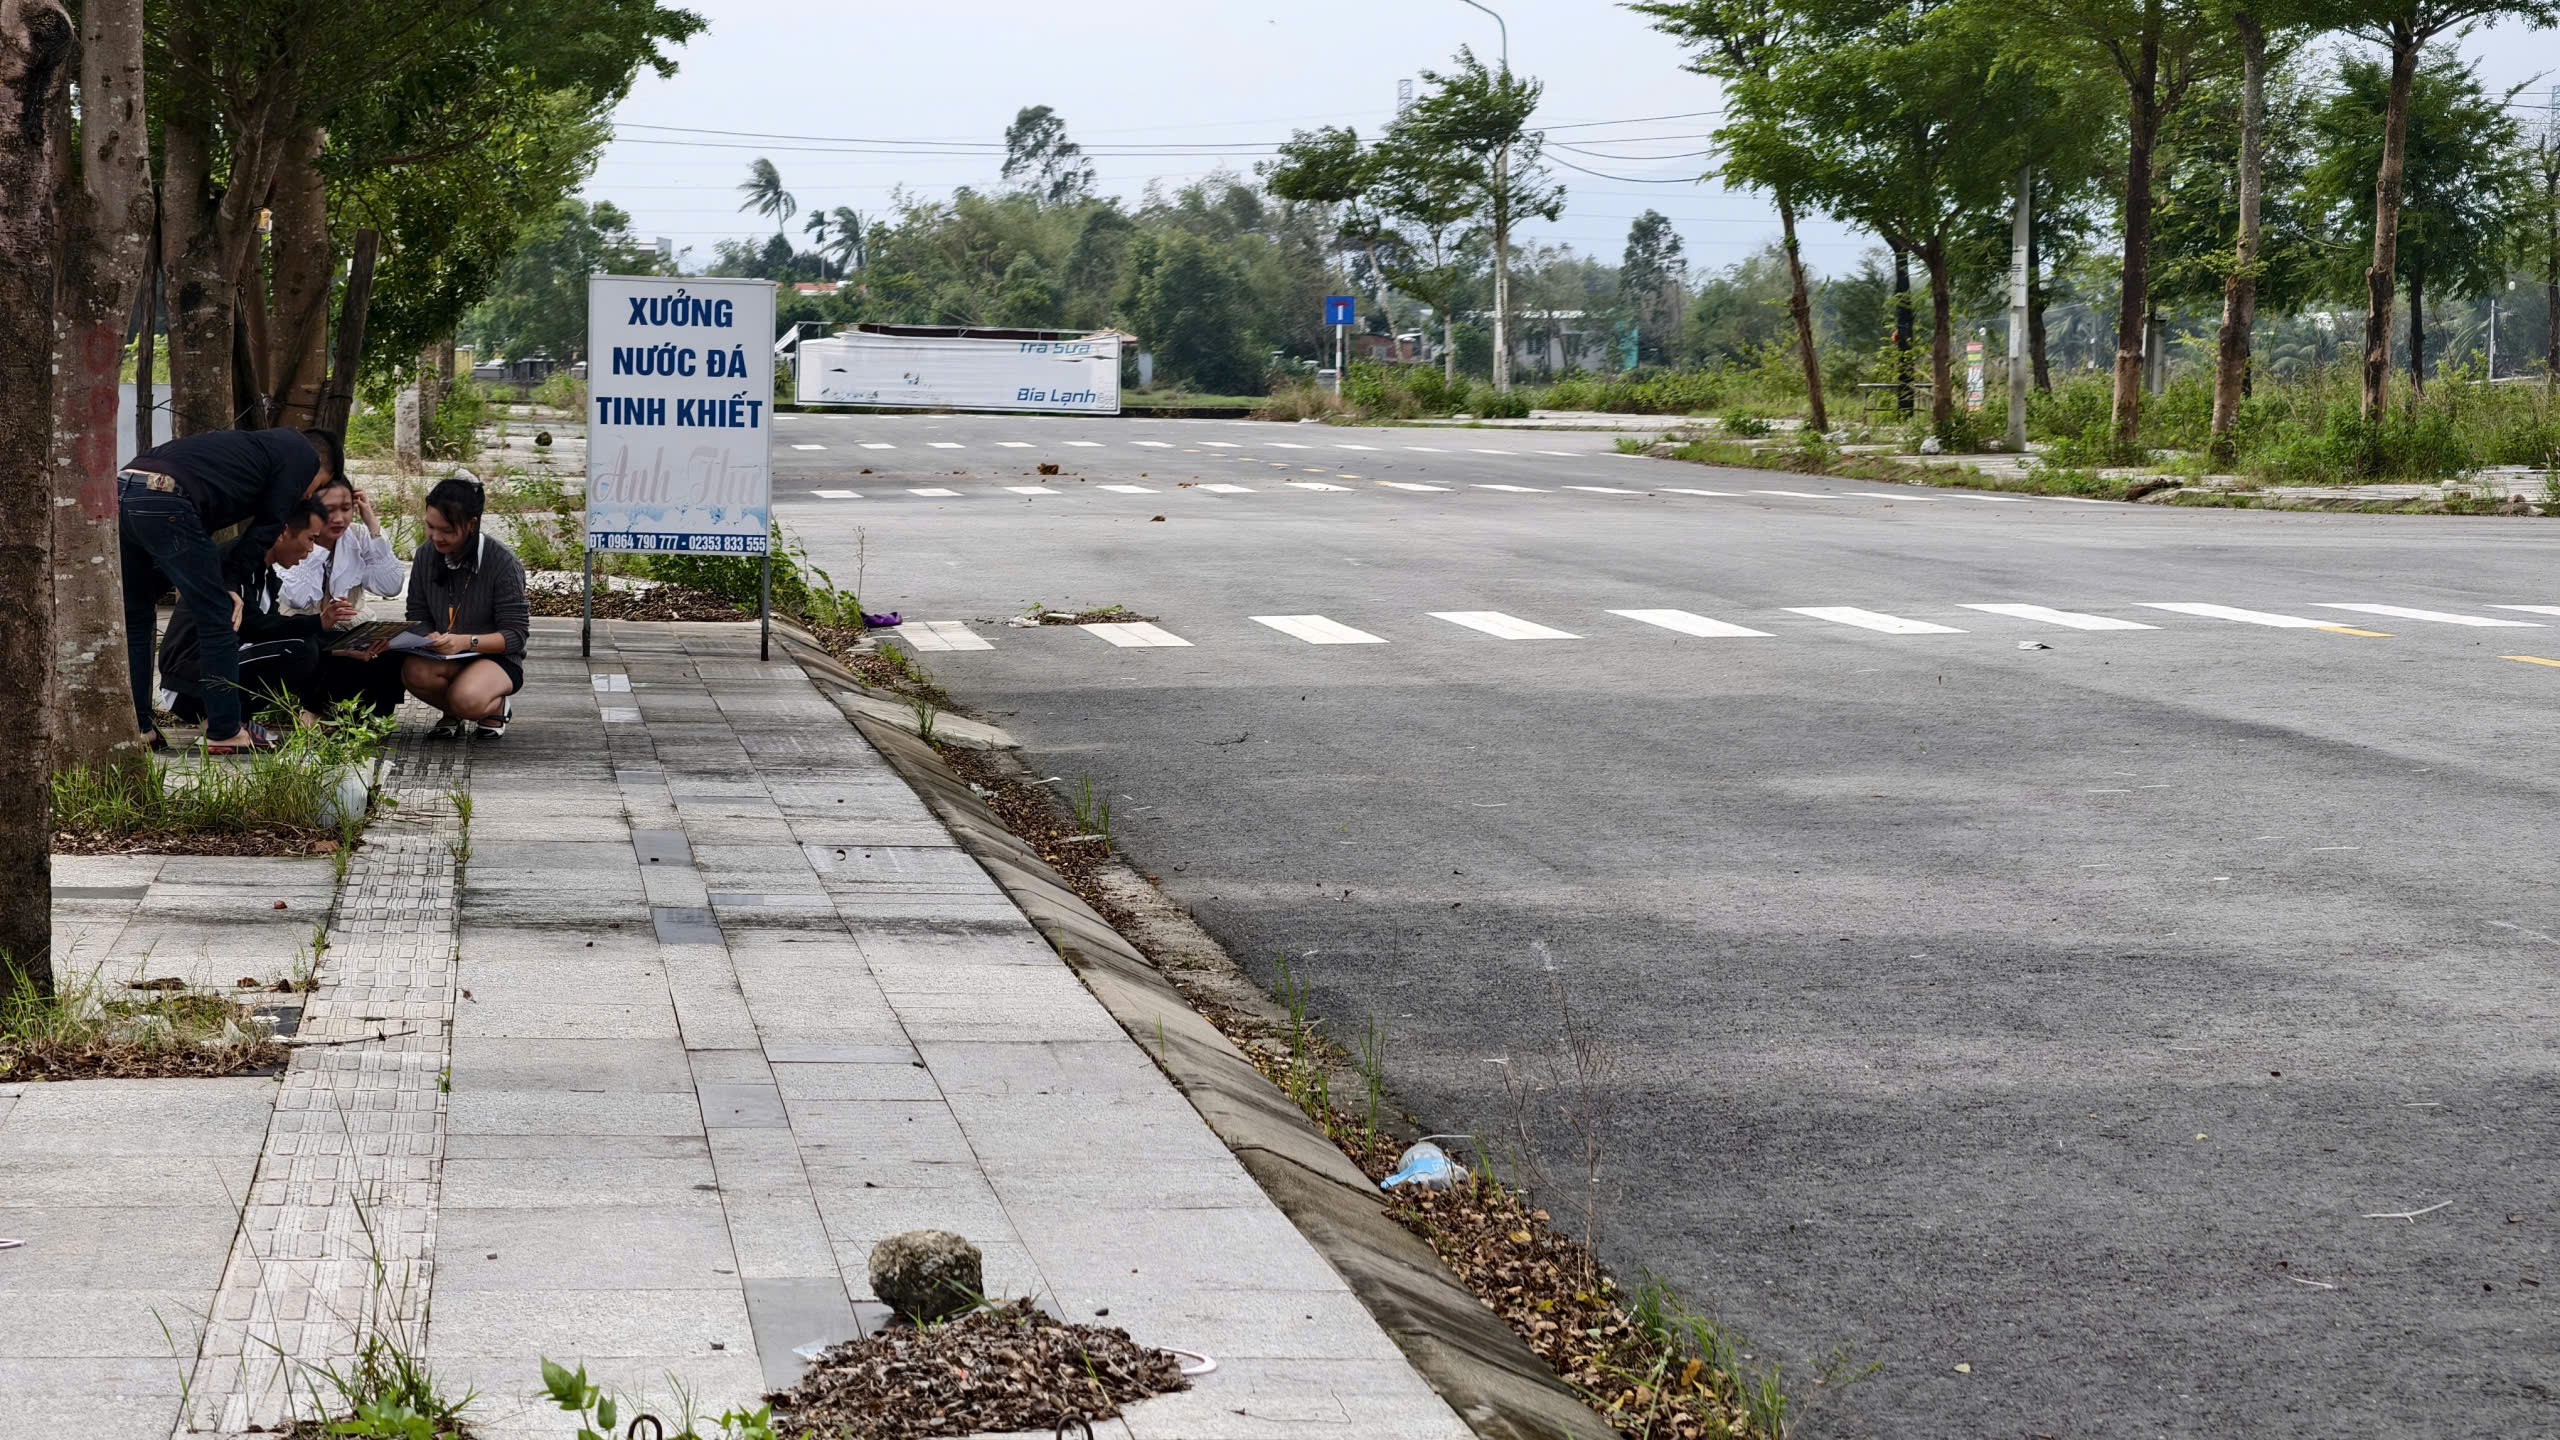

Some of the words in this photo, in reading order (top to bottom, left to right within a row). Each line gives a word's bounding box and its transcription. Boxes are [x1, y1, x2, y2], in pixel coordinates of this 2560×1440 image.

[628, 288, 733, 328] XƯỞNG
[612, 342, 696, 377] NƯỚC
[706, 343, 747, 378] ĐÁ
[596, 397, 666, 426] TINH
[677, 391, 763, 428] KHIẾT
[1017, 387, 1046, 401] Bia
[1051, 389, 1096, 406] Lạnh
[607, 533, 634, 549] 0964
[637, 534, 657, 550] 790
[659, 535, 679, 550] 777
[689, 535, 721, 551] 02353
[724, 536, 744, 551] 833
[746, 537, 766, 551] 555
